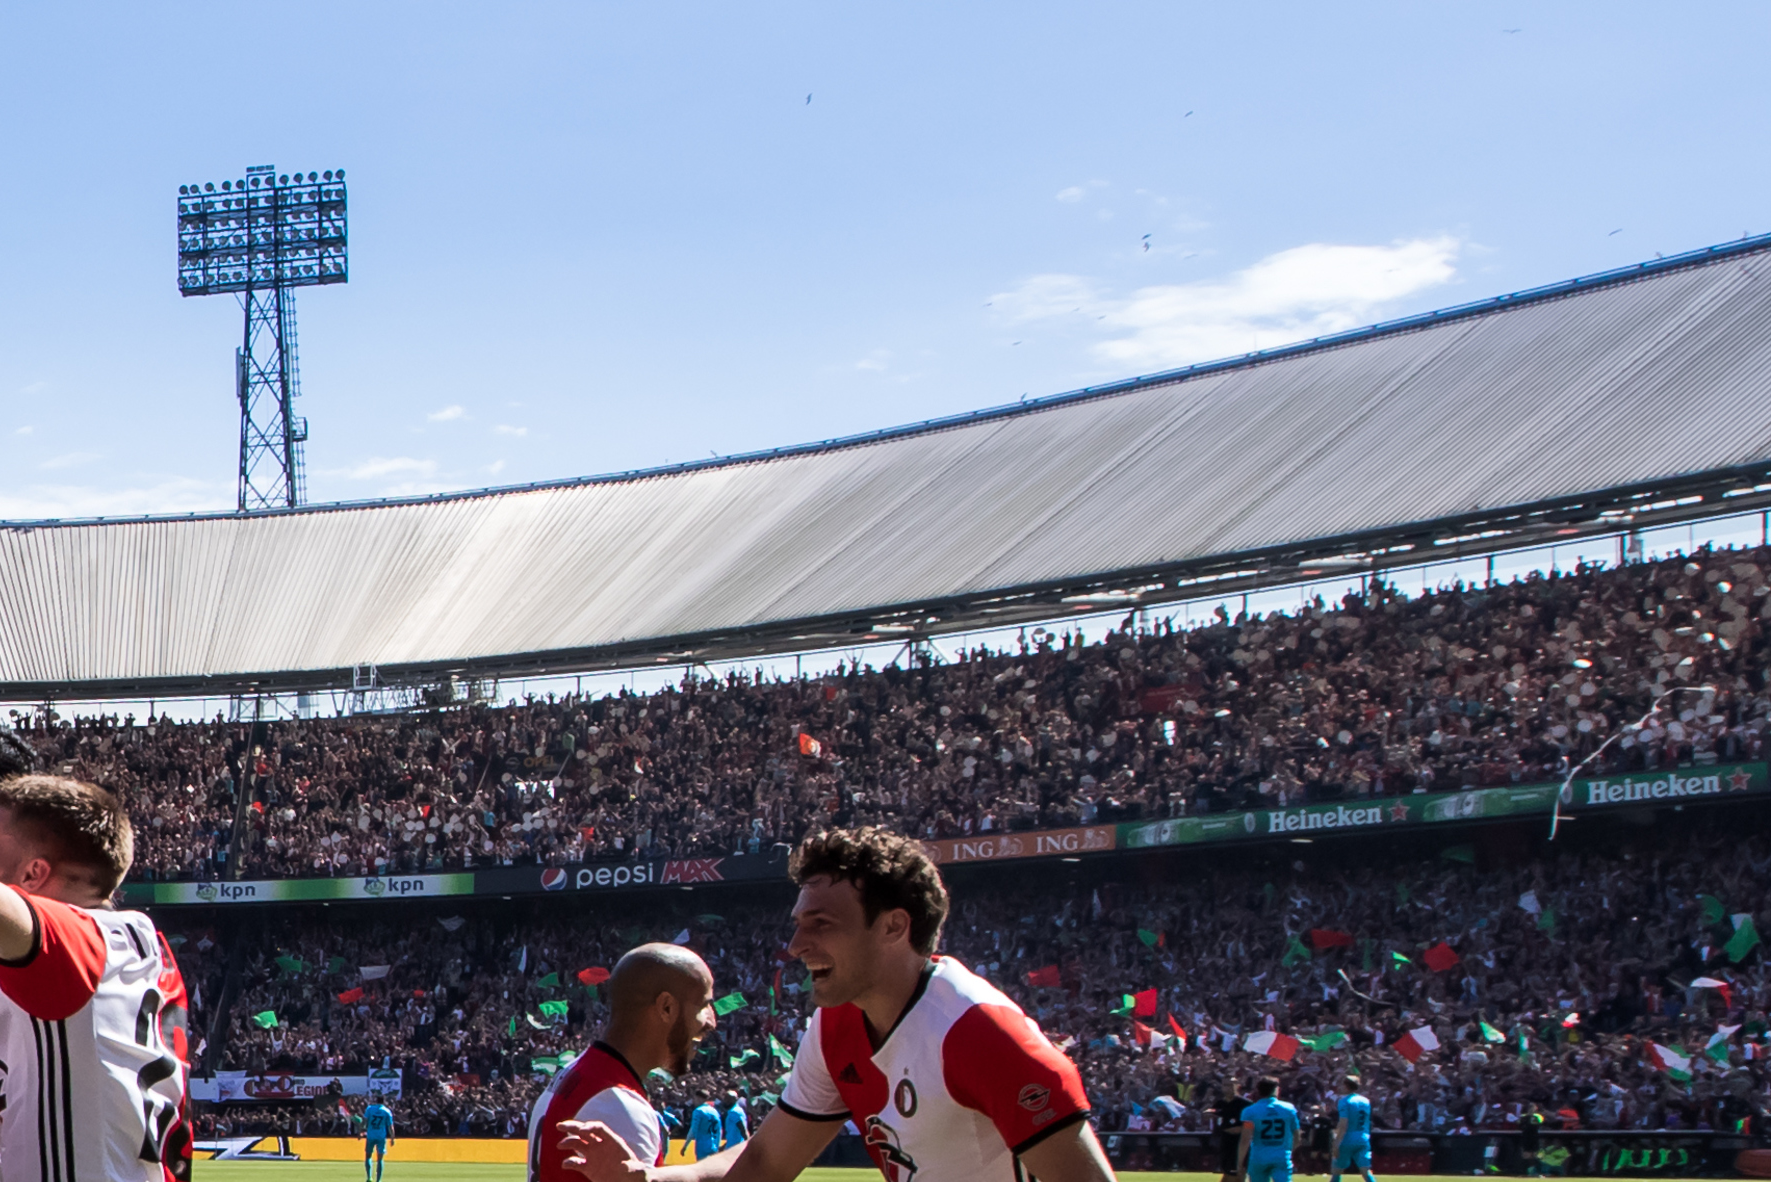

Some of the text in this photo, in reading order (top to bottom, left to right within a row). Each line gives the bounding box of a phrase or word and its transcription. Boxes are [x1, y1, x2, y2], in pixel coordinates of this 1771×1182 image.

[1587, 774, 1721, 806] Heineken
[1268, 806, 1382, 833] Heineken
[952, 841, 994, 860] ING
[1036, 833, 1078, 853] ING
[576, 857, 726, 889] pepsi MAX
[220, 883, 256, 900] kpn
[389, 877, 424, 895] kpn
[371, 1115, 383, 1126] 27
[1261, 1119, 1285, 1139] 23
